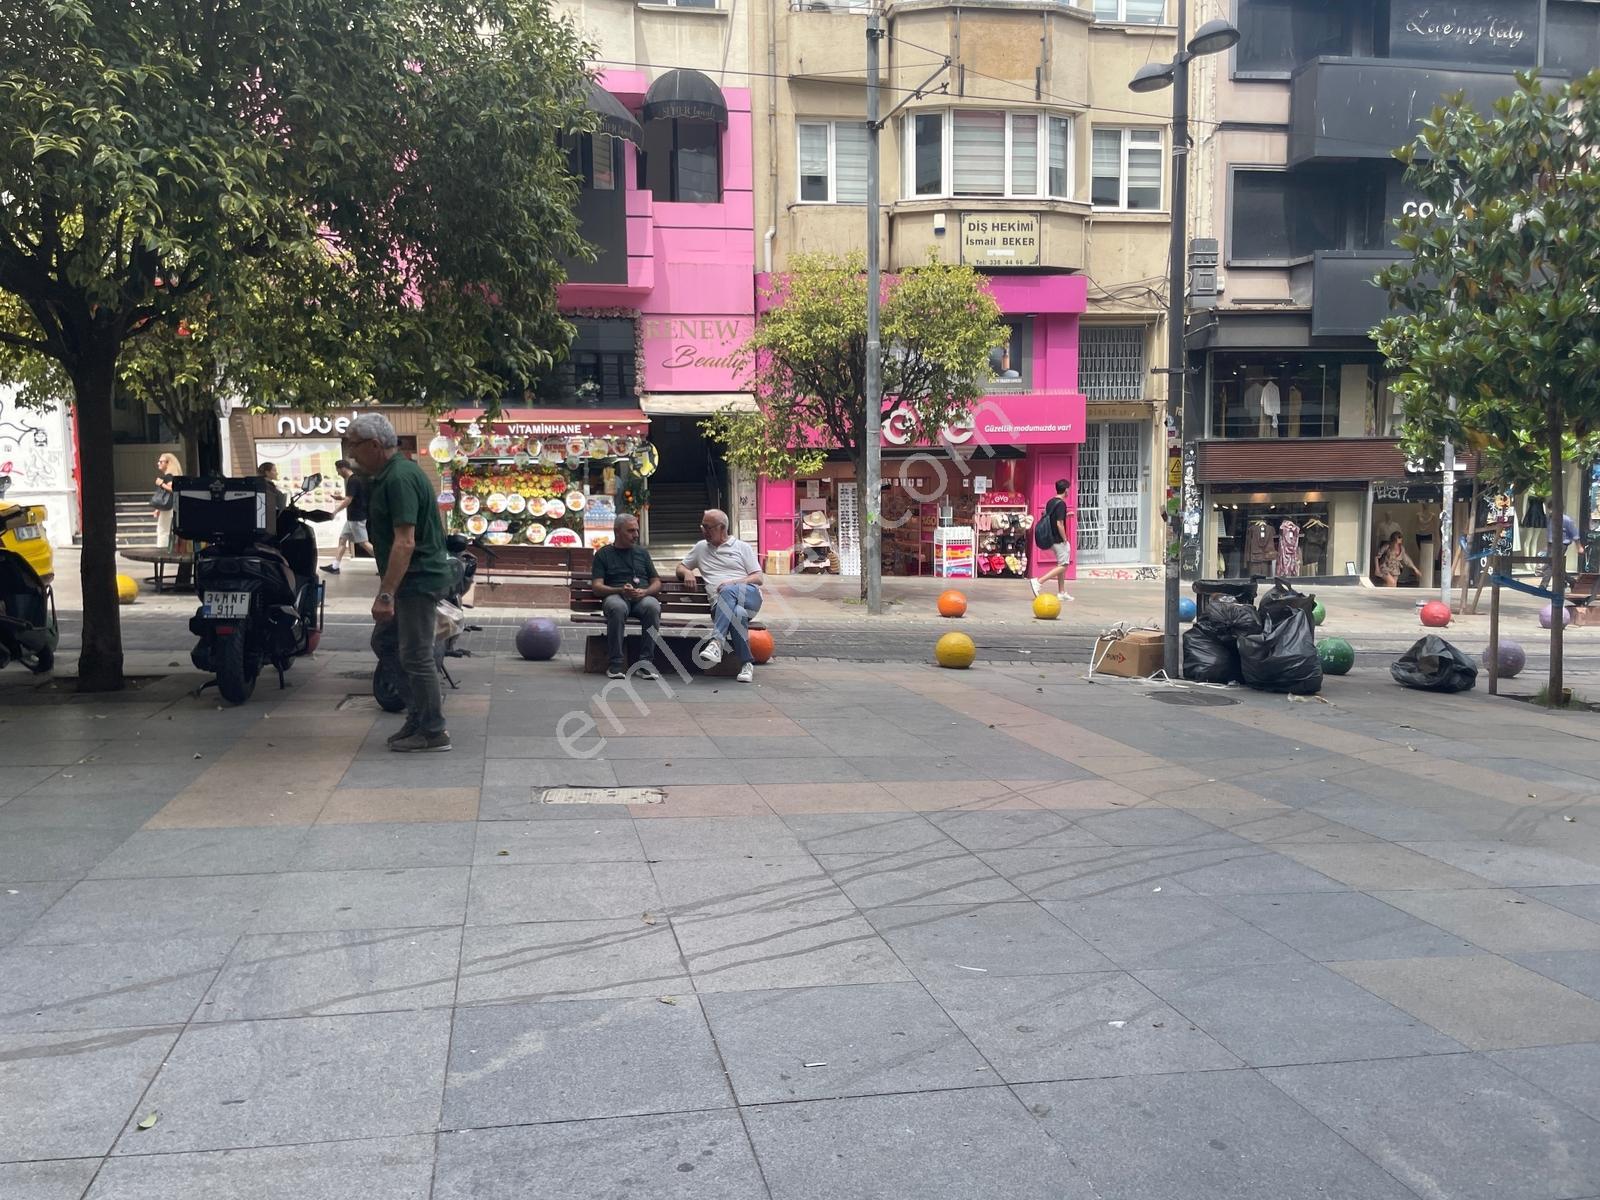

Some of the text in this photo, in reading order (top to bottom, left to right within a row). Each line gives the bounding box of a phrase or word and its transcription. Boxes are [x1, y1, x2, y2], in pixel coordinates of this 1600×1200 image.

[968, 220, 1034, 234] DİŞ HEKİMİ
[966, 234, 1035, 246] İsmail BEKER
[646, 319, 741, 340] RENEW
[661, 344, 748, 380] Beauty
[508, 423, 583, 435] VİTAMİNHANE
[984, 423, 1073, 433] Güzellik modumuzda var!
[994, 494, 1009, 503] eve
[217, 605, 234, 616] 911
